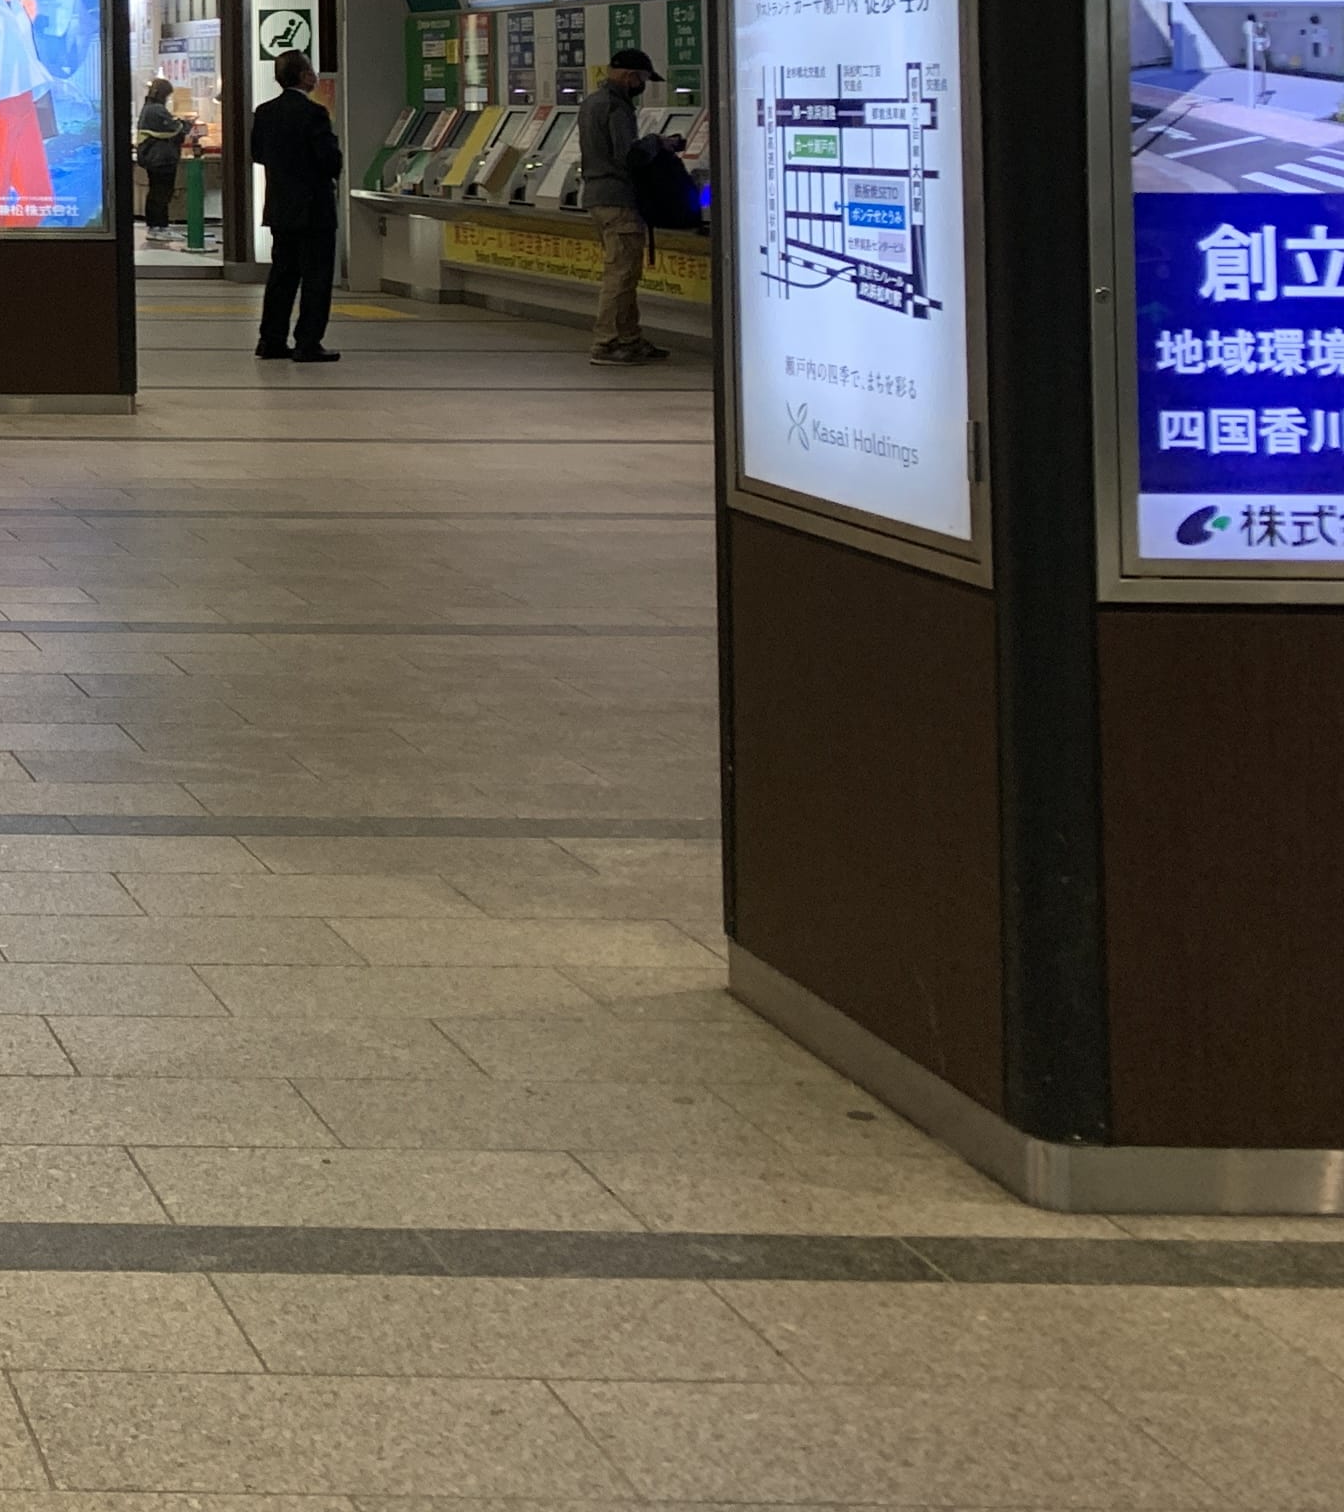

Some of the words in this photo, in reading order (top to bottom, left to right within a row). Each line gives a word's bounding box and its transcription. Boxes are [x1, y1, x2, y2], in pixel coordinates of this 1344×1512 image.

[851, 207, 903, 224] ポンテせとうみ
[1197, 223, 1344, 302] 創立
[1155, 328, 1344, 377] 地域環境
[785, 355, 917, 399] 瀬戸内の四季で、まちを彩る
[812, 419, 849, 448] Kasai
[853, 428, 920, 468] Holdings
[1159, 407, 1344, 455] 四国香川
[1240, 504, 1344, 547] 株式
